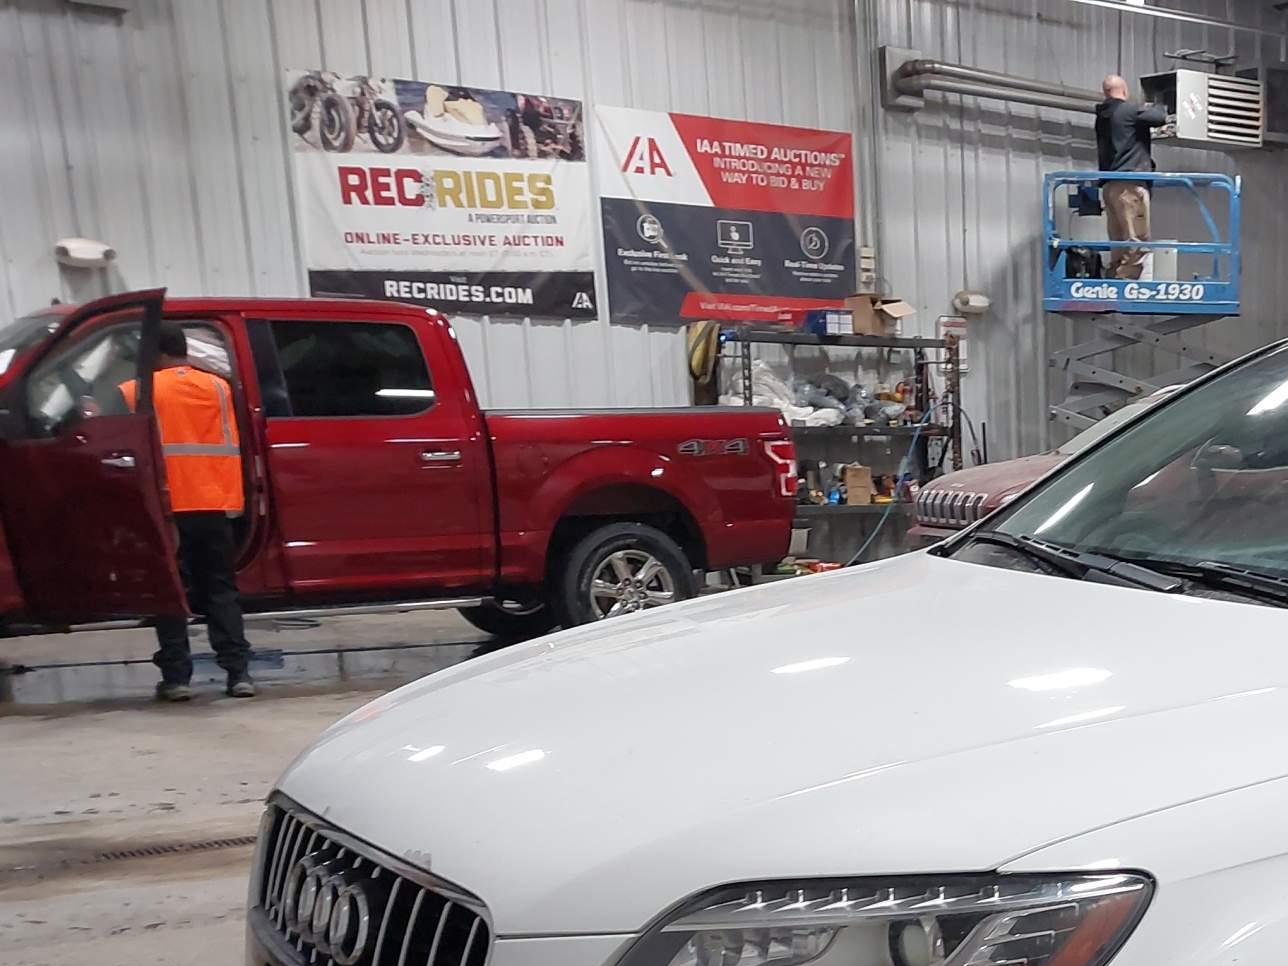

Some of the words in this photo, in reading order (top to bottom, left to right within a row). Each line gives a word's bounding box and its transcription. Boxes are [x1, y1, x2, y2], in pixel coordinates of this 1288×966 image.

[696, 139, 720, 155] IAA
[722, 142, 768, 159] TIMED
[713, 157, 791, 175] INTRODUCING
[794, 165, 803, 176] A
[806, 166, 833, 178] NEW
[337, 166, 426, 207] REC
[432, 170, 556, 210] RIDES
[721, 171, 748, 184] WAY
[751, 174, 767, 186] TO
[769, 176, 788, 188] BID
[790, 178, 799, 189] &
[802, 179, 826, 191] BUY
[344, 232, 497, 246] ONLINE-EXCLUSIVE
[503, 235, 565, 247] AUCTION
[384, 280, 533, 304] RECRIDES.COM
[1070, 282, 1118, 298] Genie
